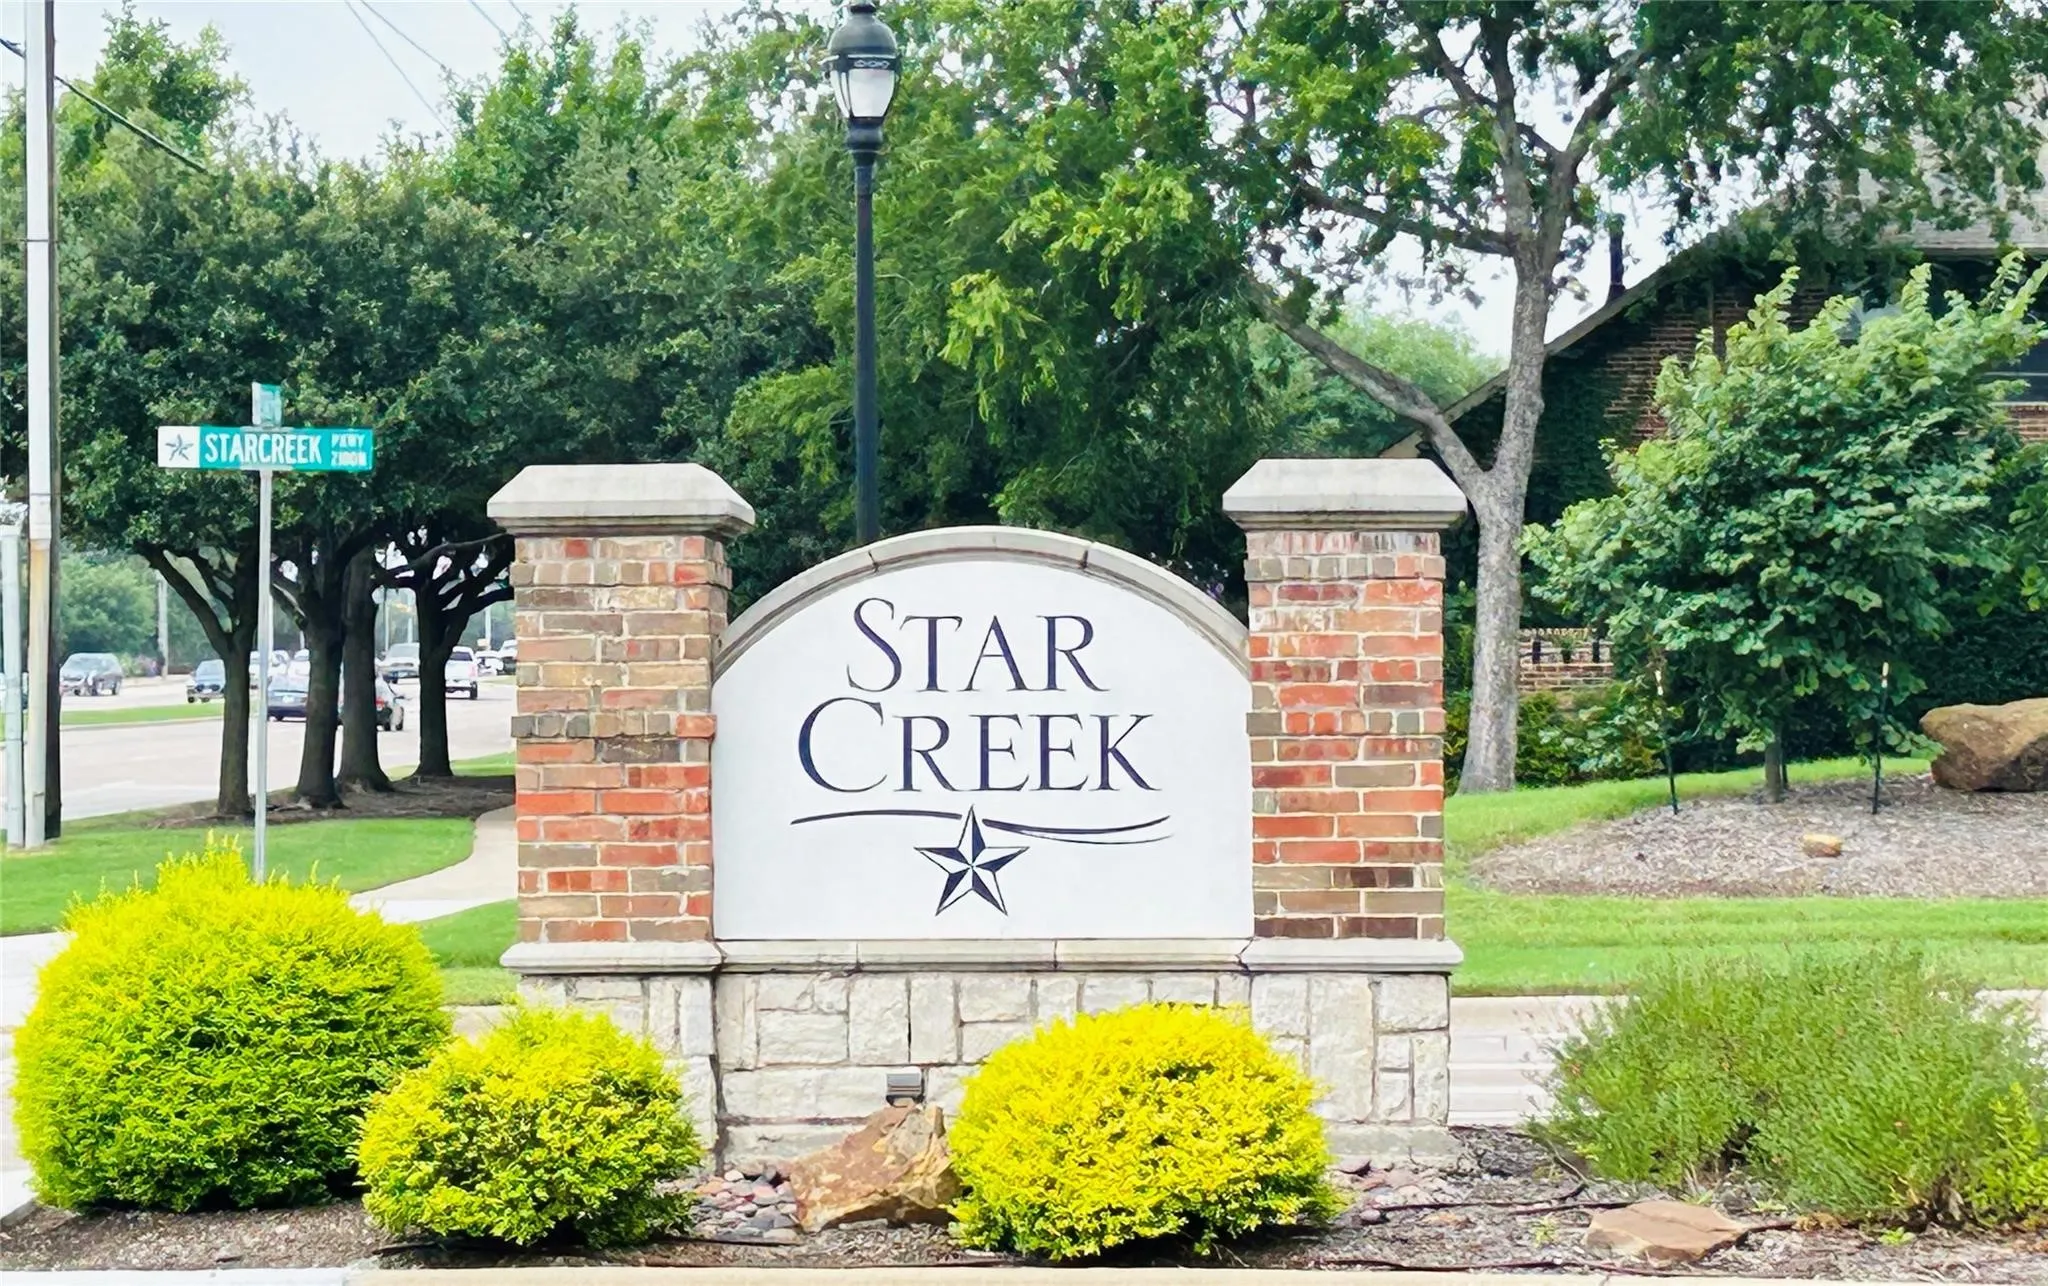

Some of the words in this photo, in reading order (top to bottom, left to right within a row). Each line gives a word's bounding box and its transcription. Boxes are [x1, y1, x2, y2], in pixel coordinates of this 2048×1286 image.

[204, 432, 322, 465] STARCREEK
[846, 597, 1110, 693] STAR
[798, 696, 1162, 793] CREEK
